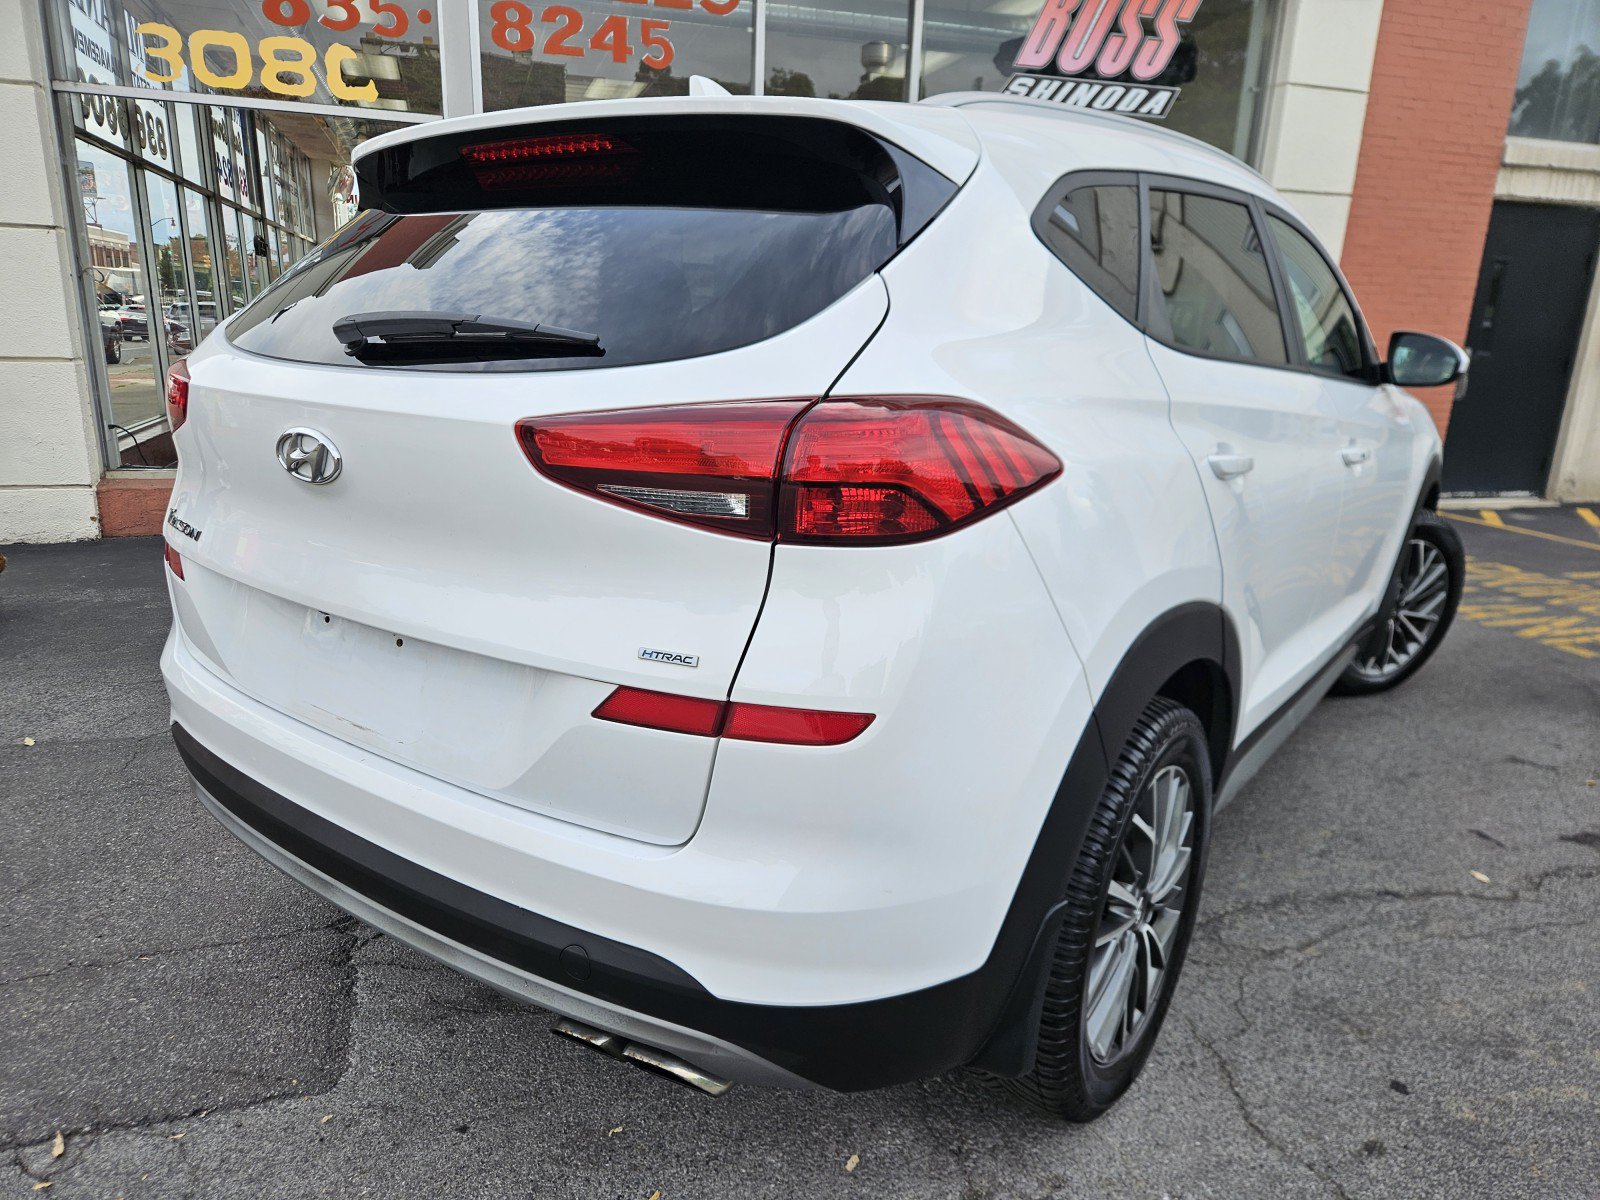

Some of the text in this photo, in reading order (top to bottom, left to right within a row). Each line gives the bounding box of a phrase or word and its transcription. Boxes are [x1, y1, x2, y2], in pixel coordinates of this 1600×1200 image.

[135, 22, 379, 103] 308C
[490, 0, 675, 70] 8245
[1013, 0, 1201, 81] BOSS
[1003, 77, 1173, 115] SHINODA
[641, 649, 694, 665] HTRAC
